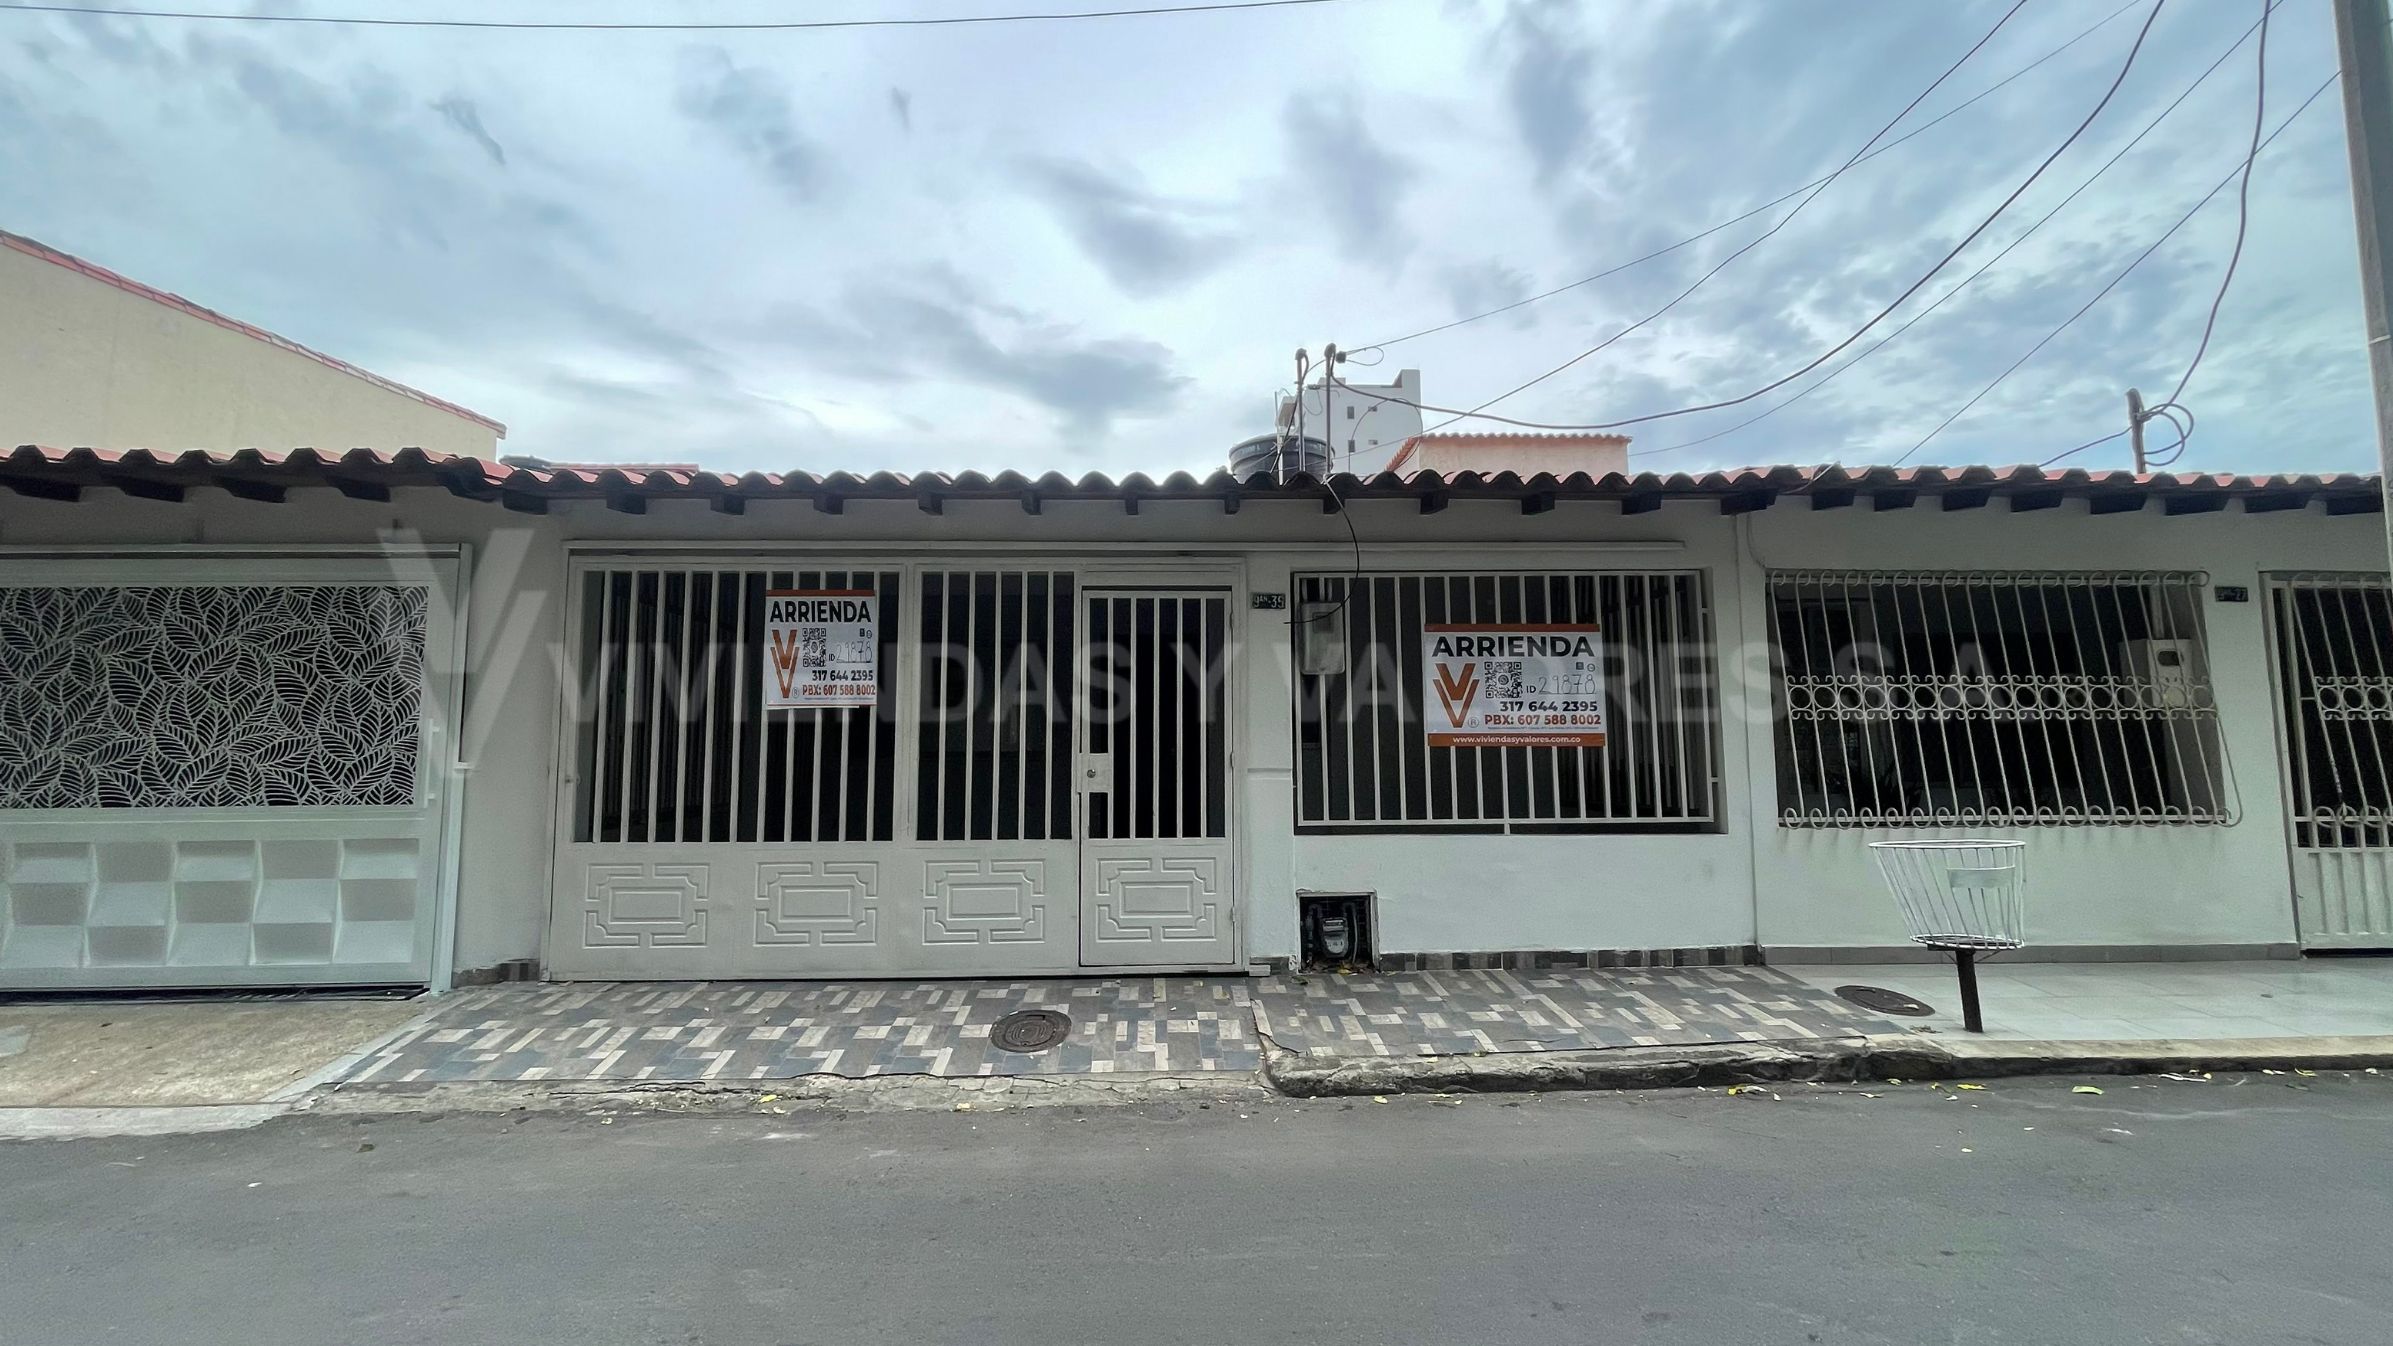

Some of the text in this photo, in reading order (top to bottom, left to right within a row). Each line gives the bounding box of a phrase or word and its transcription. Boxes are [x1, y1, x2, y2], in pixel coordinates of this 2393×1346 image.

[770, 600, 872, 623] ARRIENDA
[1431, 636, 1596, 658] ARRIENDA
[828, 653, 836, 662] ID
[812, 670, 874, 681] 317 644 2395
[802, 684, 876, 696] PBX: 607 588 8002
[1526, 686, 1537, 694] ID
[1500, 701, 1598, 712] 317 644 2395
[1484, 714, 1602, 726] PBX: 607 588 8002
[1452, 736, 1582, 744] www.viviendasyvalores.com.co
